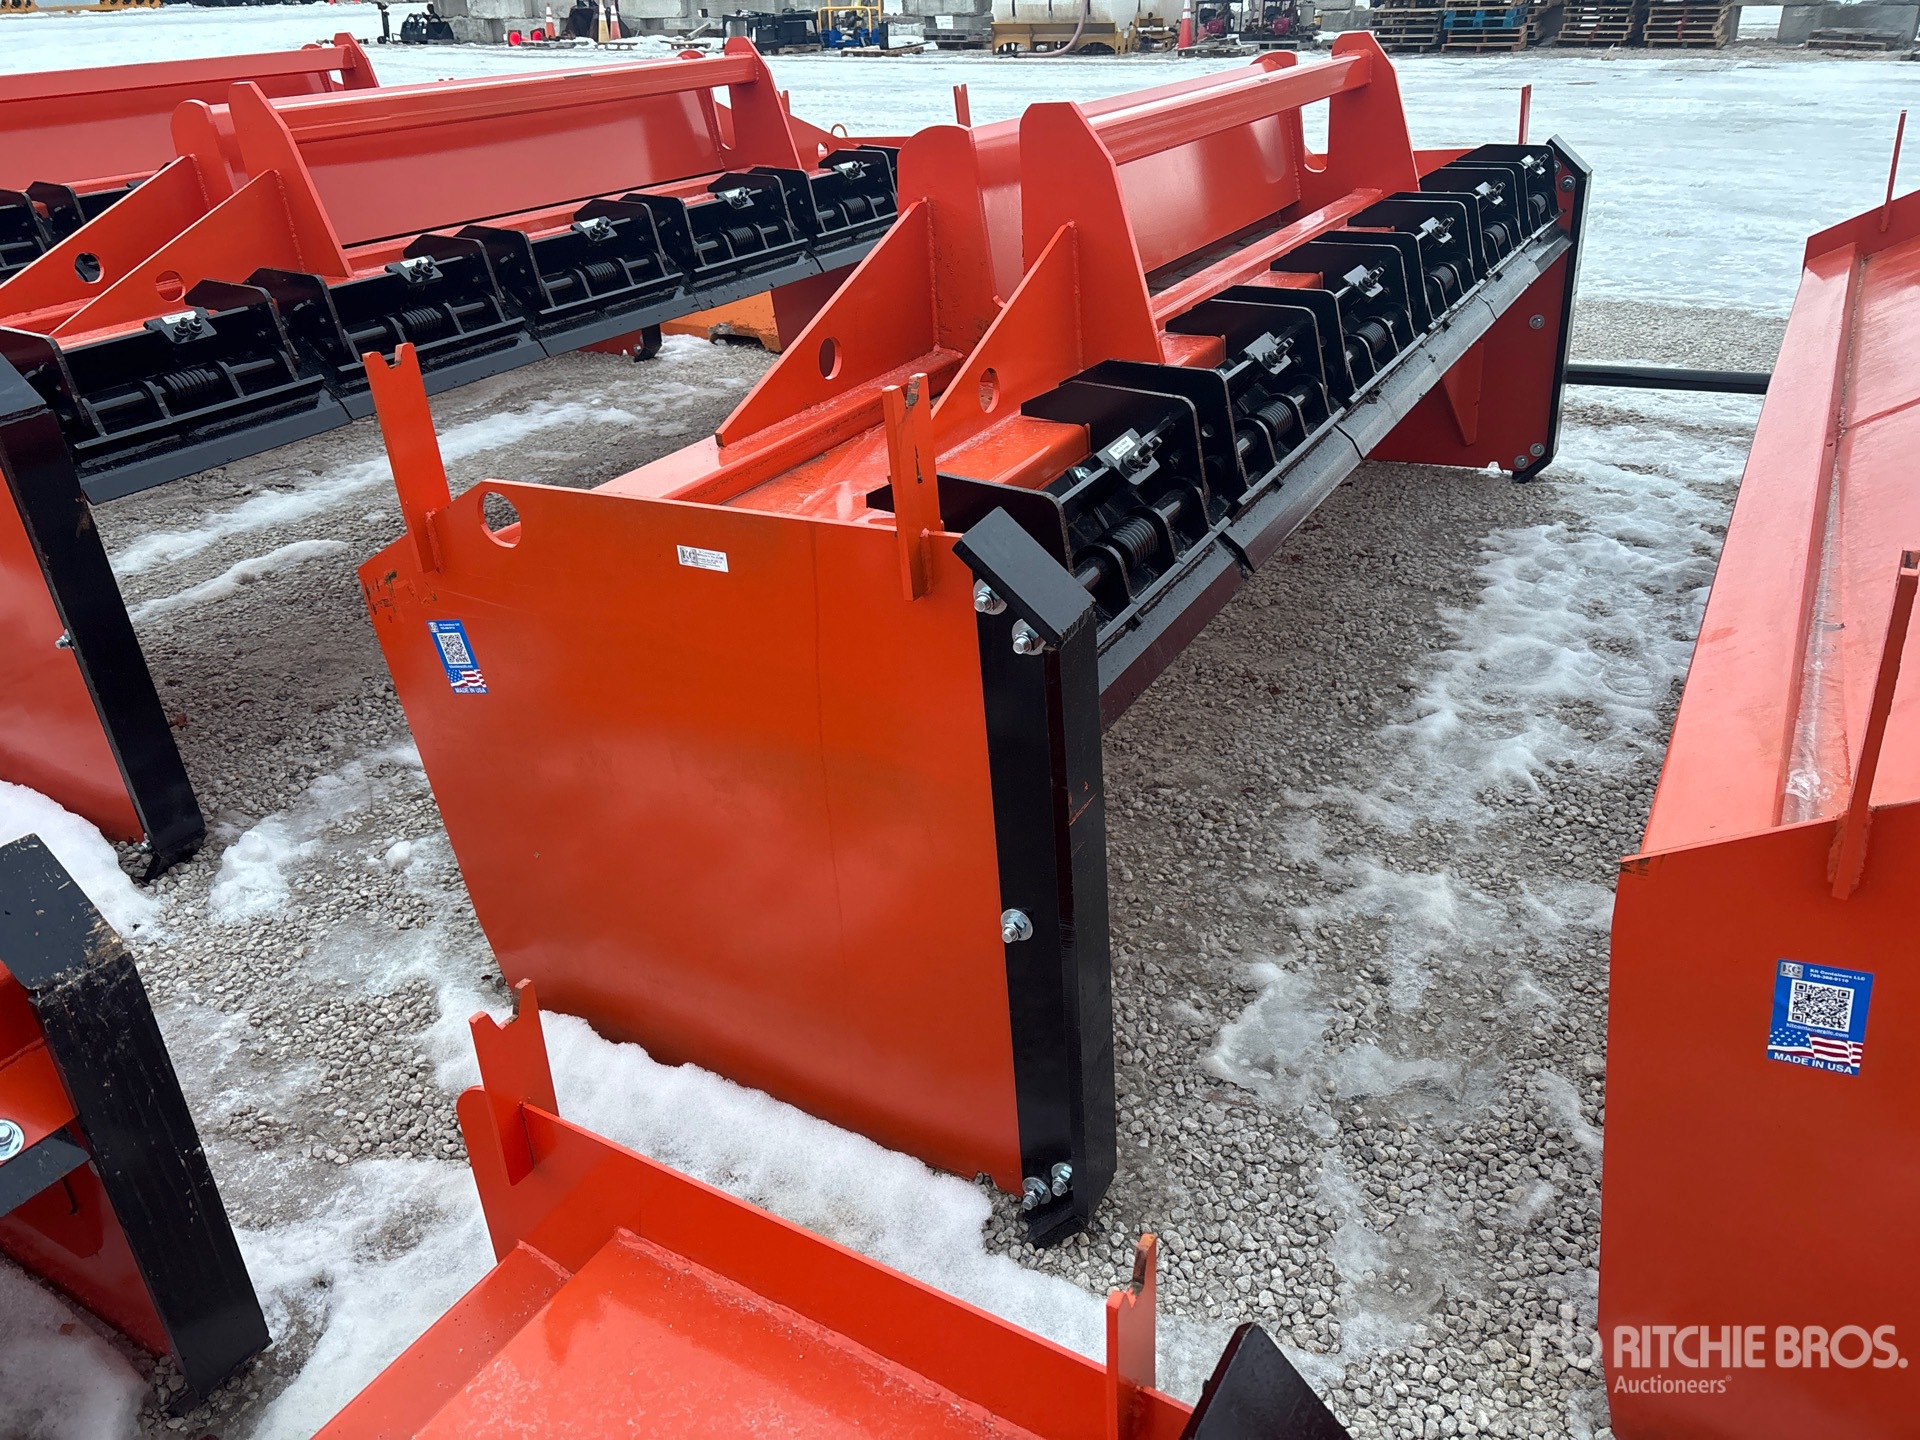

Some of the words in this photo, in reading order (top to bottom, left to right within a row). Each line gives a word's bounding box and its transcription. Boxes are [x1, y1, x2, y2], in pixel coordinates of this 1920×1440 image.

[1773, 1052, 1809, 1066] MADE
[1812, 1059, 1824, 1069] IN
[1827, 1062, 1853, 1075] USA
